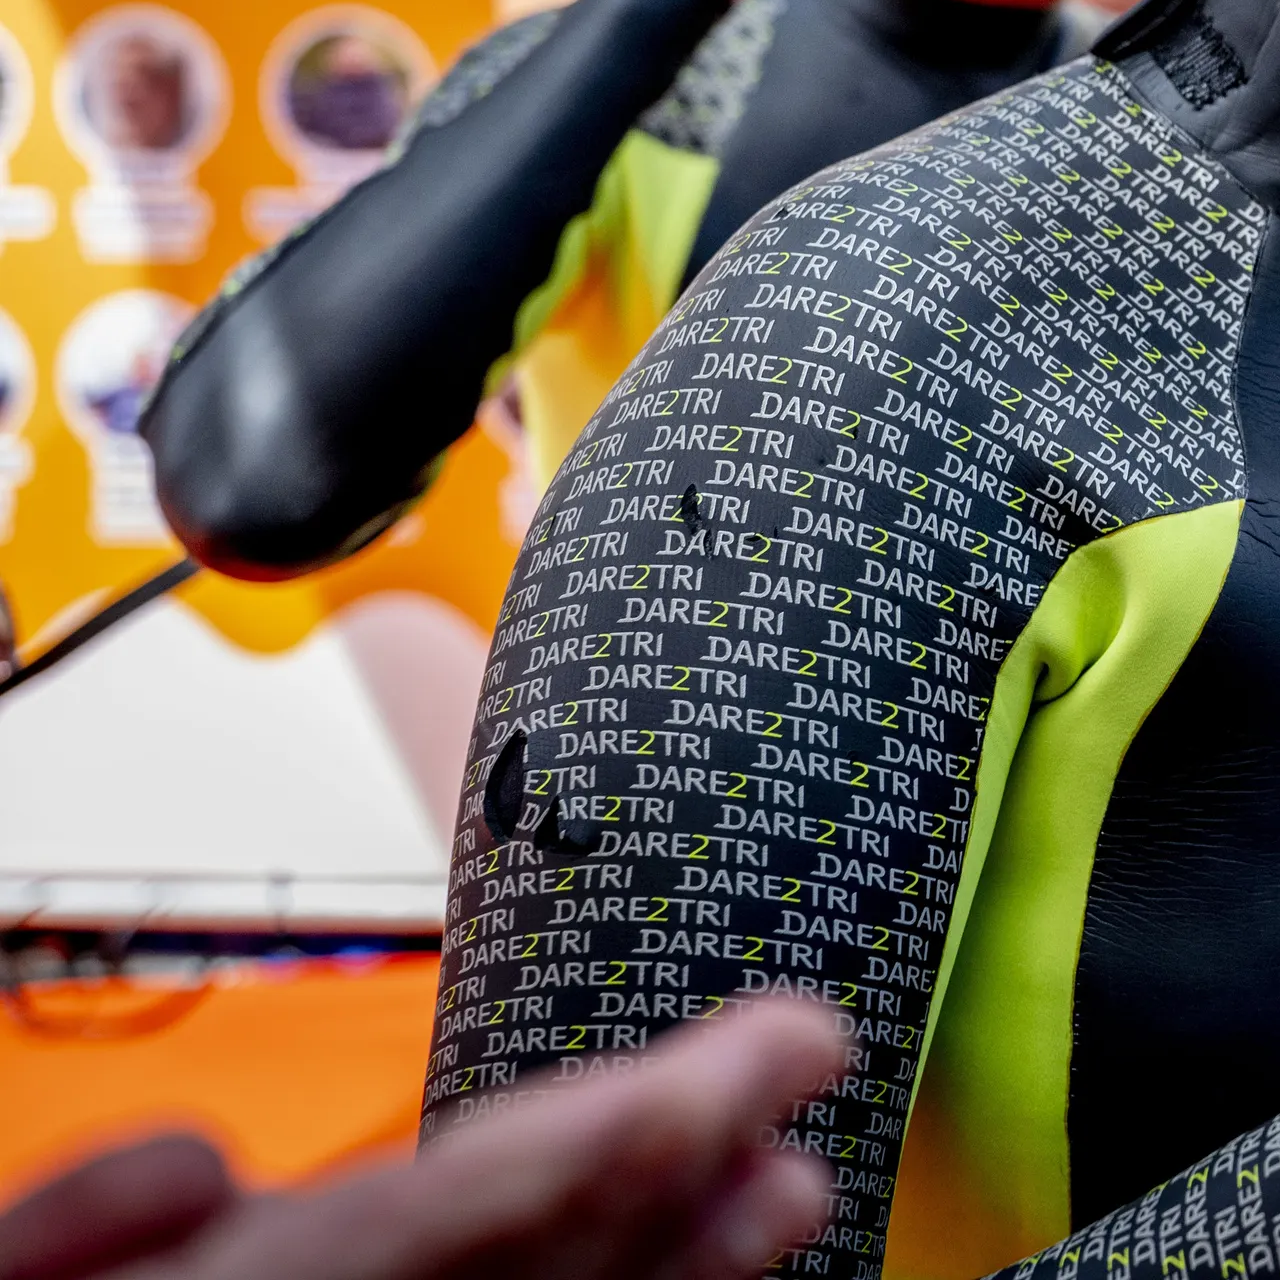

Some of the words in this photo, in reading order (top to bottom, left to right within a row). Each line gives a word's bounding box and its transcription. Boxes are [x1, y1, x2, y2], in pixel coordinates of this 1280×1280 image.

[979, 105, 1078, 161] DARE2TRI
[1026, 88, 1129, 153] DARE2TRI
[947, 143, 1065, 215] DARE2TRI
[1002, 132, 1116, 211] DARE2TRI
[1055, 122, 1168, 204] DARE2TRI
[1106, 111, 1220, 192] DARE2TRI
[827, 172, 961, 219] DARE2TRI
[889, 152, 1014, 216] DARE2TRI
[872, 196, 1013, 282] DARE2TRI
[934, 184, 1061, 277] DARE2TRI
[990, 181, 1110, 273] DARE2TRI
[1041, 180, 1160, 268] DARE2TRI
[1093, 174, 1212, 261] DARE2TRI
[706, 252, 837, 282] DARE2TRI
[806, 228, 960, 302] DARE2TRI
[982, 236, 1106, 337] DARE2TRI
[1033, 234, 1151, 332] DARE2TRI
[1082, 230, 1200, 326] DARE2TRI
[744, 283, 902, 342] DARE2TRI
[863, 274, 1010, 371] DARE2TRI
[924, 246, 1060, 348] DARE2TRI
[655, 316, 775, 355] DARE2TRI
[982, 313, 1113, 413] DARE2TRI
[1032, 300, 1157, 400] DARE2TRI
[1080, 295, 1197, 395] DARE2TRI
[691, 353, 845, 396] DARE2TRI
[802, 326, 958, 408] DARE2TRI
[927, 343, 1066, 435] DARE2TRI
[607, 388, 722, 428] DARE2TRI
[750, 391, 909, 456] DARE2TRI
[874, 388, 1014, 474] DARE2TRI
[1032, 379, 1162, 476] DARE2TRI
[1081, 363, 1205, 460] DARE2TRI
[644, 425, 794, 459] DARE2TRI
[980, 409, 1116, 499] DARE2TRI
[563, 459, 674, 502] DARE2TRI
[705, 460, 865, 511] DARE2TRI
[826, 444, 972, 519] DARE2TRI
[935, 451, 1065, 530] DARE2TRI
[524, 532, 628, 579] DARE2TRI
[783, 506, 935, 571] DARE2TRI
[894, 502, 1030, 575] DARE2TRI
[998, 515, 1076, 560] DARE
[559, 564, 703, 599] DARE2TRI
[739, 572, 901, 629] DARE2TRI
[856, 559, 997, 628] DARE2TRI
[963, 562, 1044, 606] DARE
[492, 604, 588, 658] DARE2TRI
[617, 598, 784, 635] DARE2TRI
[933, 618, 1013, 661] DARE
[522, 632, 663, 675] DARE2TRI
[700, 636, 870, 689] DARE2TRI
[821, 620, 968, 684] DARE2TRI
[582, 664, 747, 698] DARE2TRI
[664, 699, 838, 749] DARE2TRI
[786, 682, 944, 742] DARE2TRI
[555, 729, 711, 760] DARE2TRI
[751, 743, 918, 800] DARE2TRI
[630, 764, 804, 808] DARE2TRI
[588, 831, 768, 867] DARE2TRI
[714, 804, 889, 857] DARE2TRI
[480, 864, 633, 906] DARE2TRI
[674, 866, 857, 914] DARE2TRI
[810, 852, 954, 904] DARE2TRI
[547, 897, 730, 927] DARE2TRI
[774, 910, 929, 960] DARE2TRI
[458, 930, 591, 974] DARE2TRI
[514, 961, 689, 991] DARE2TRI
[631, 929, 822, 970] DARE2TRI
[861, 956, 935, 993] DARE
[437, 996, 553, 1043] DARE2TRI
[481, 1025, 647, 1057] DARE2TRI
